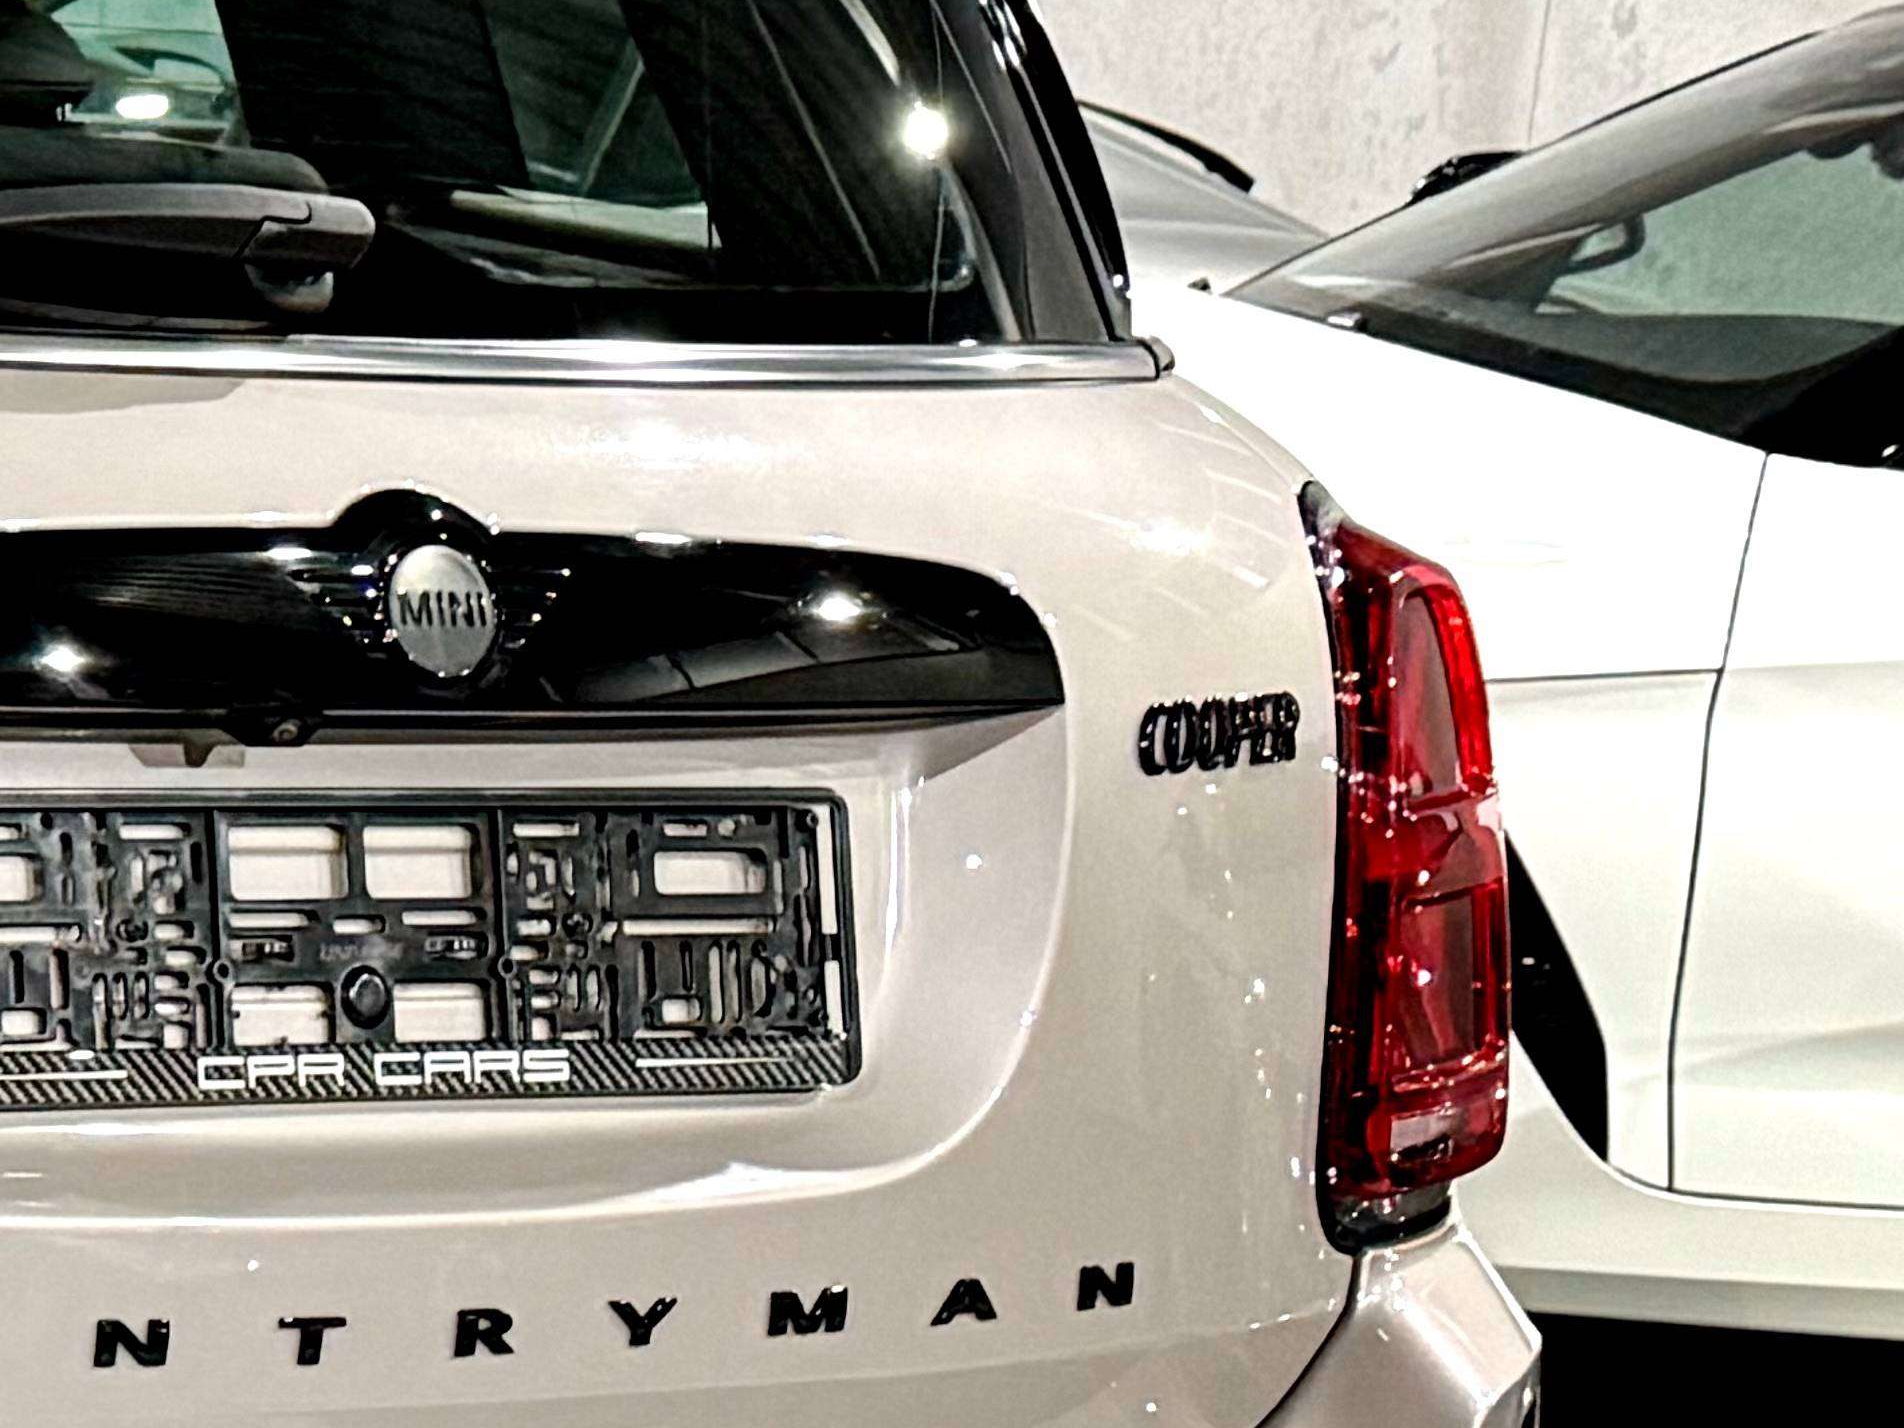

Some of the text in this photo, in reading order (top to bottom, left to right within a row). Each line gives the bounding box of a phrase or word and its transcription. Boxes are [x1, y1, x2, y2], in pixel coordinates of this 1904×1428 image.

[396, 589, 488, 628] MINI
[1136, 690, 1301, 777] COOPER
[197, 1048, 571, 1090] CPR CARS
